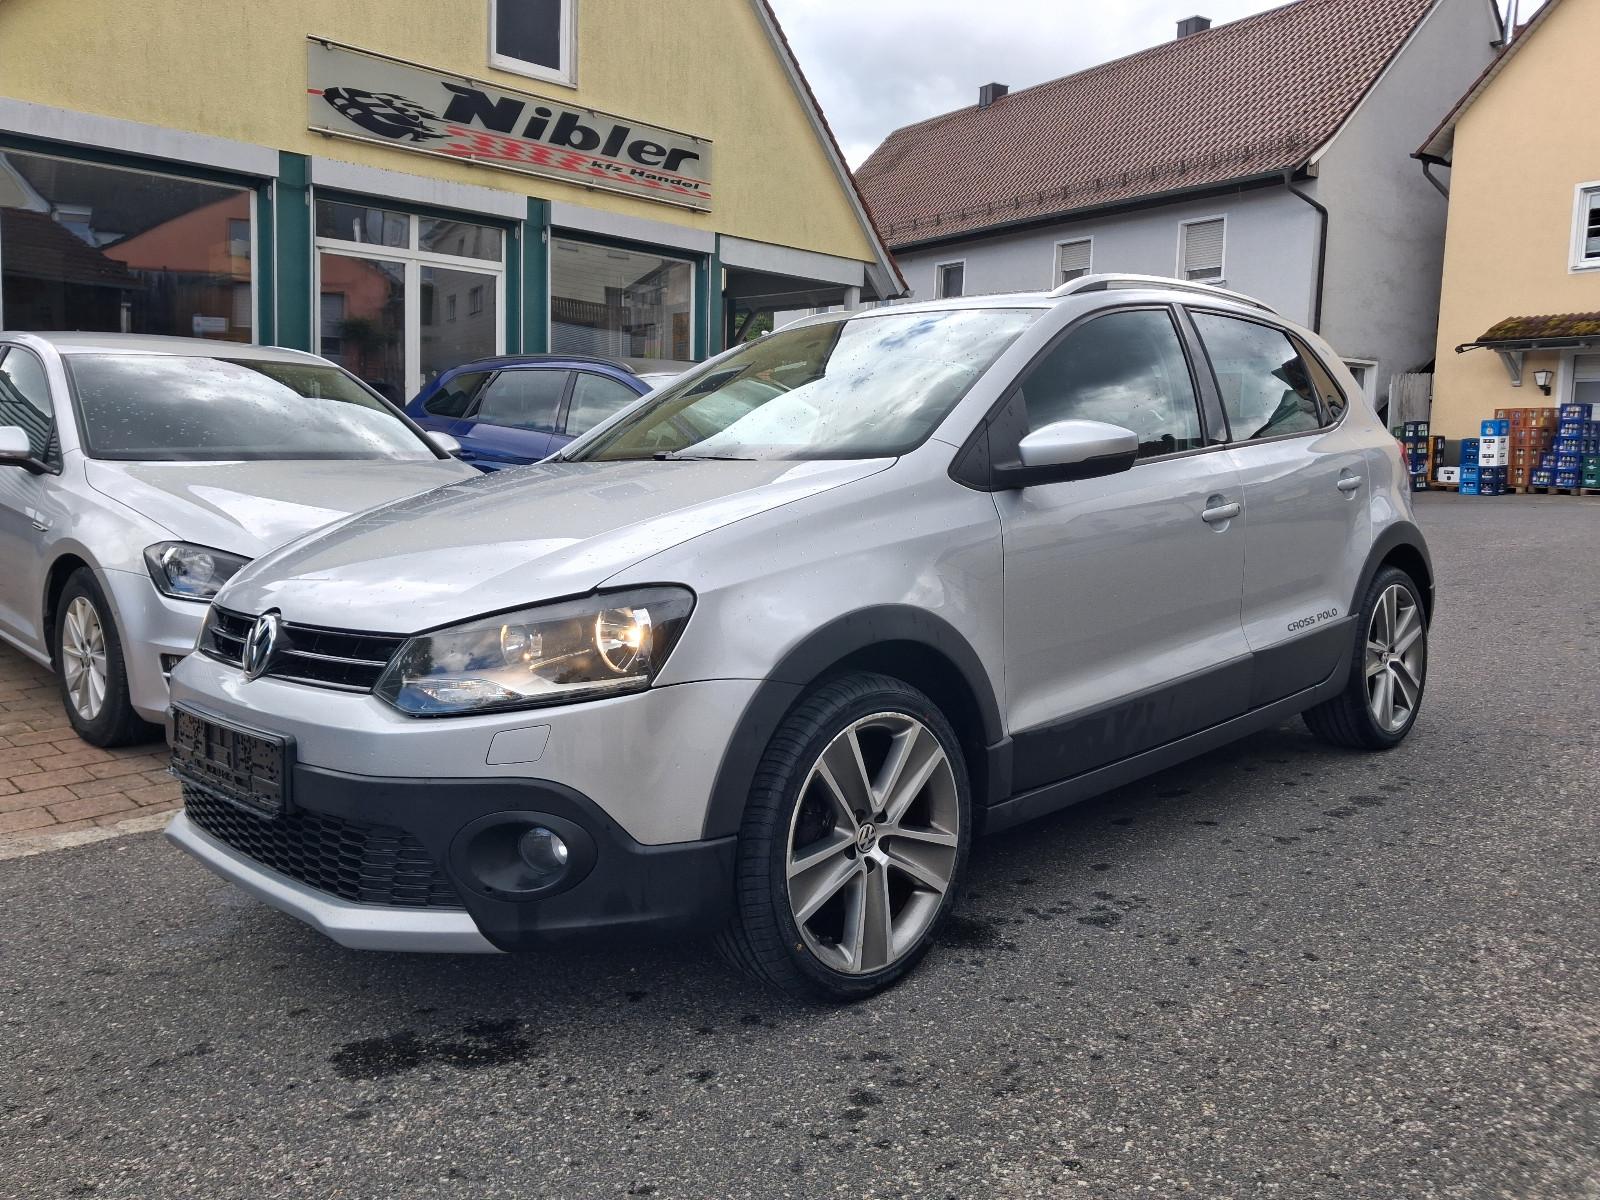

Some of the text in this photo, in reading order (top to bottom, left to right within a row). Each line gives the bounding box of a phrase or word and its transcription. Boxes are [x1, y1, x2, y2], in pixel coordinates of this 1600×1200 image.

[441, 81, 700, 171] Nibler
[630, 168, 700, 190] Handel
[1287, 608, 1338, 631] CROSS POLO
